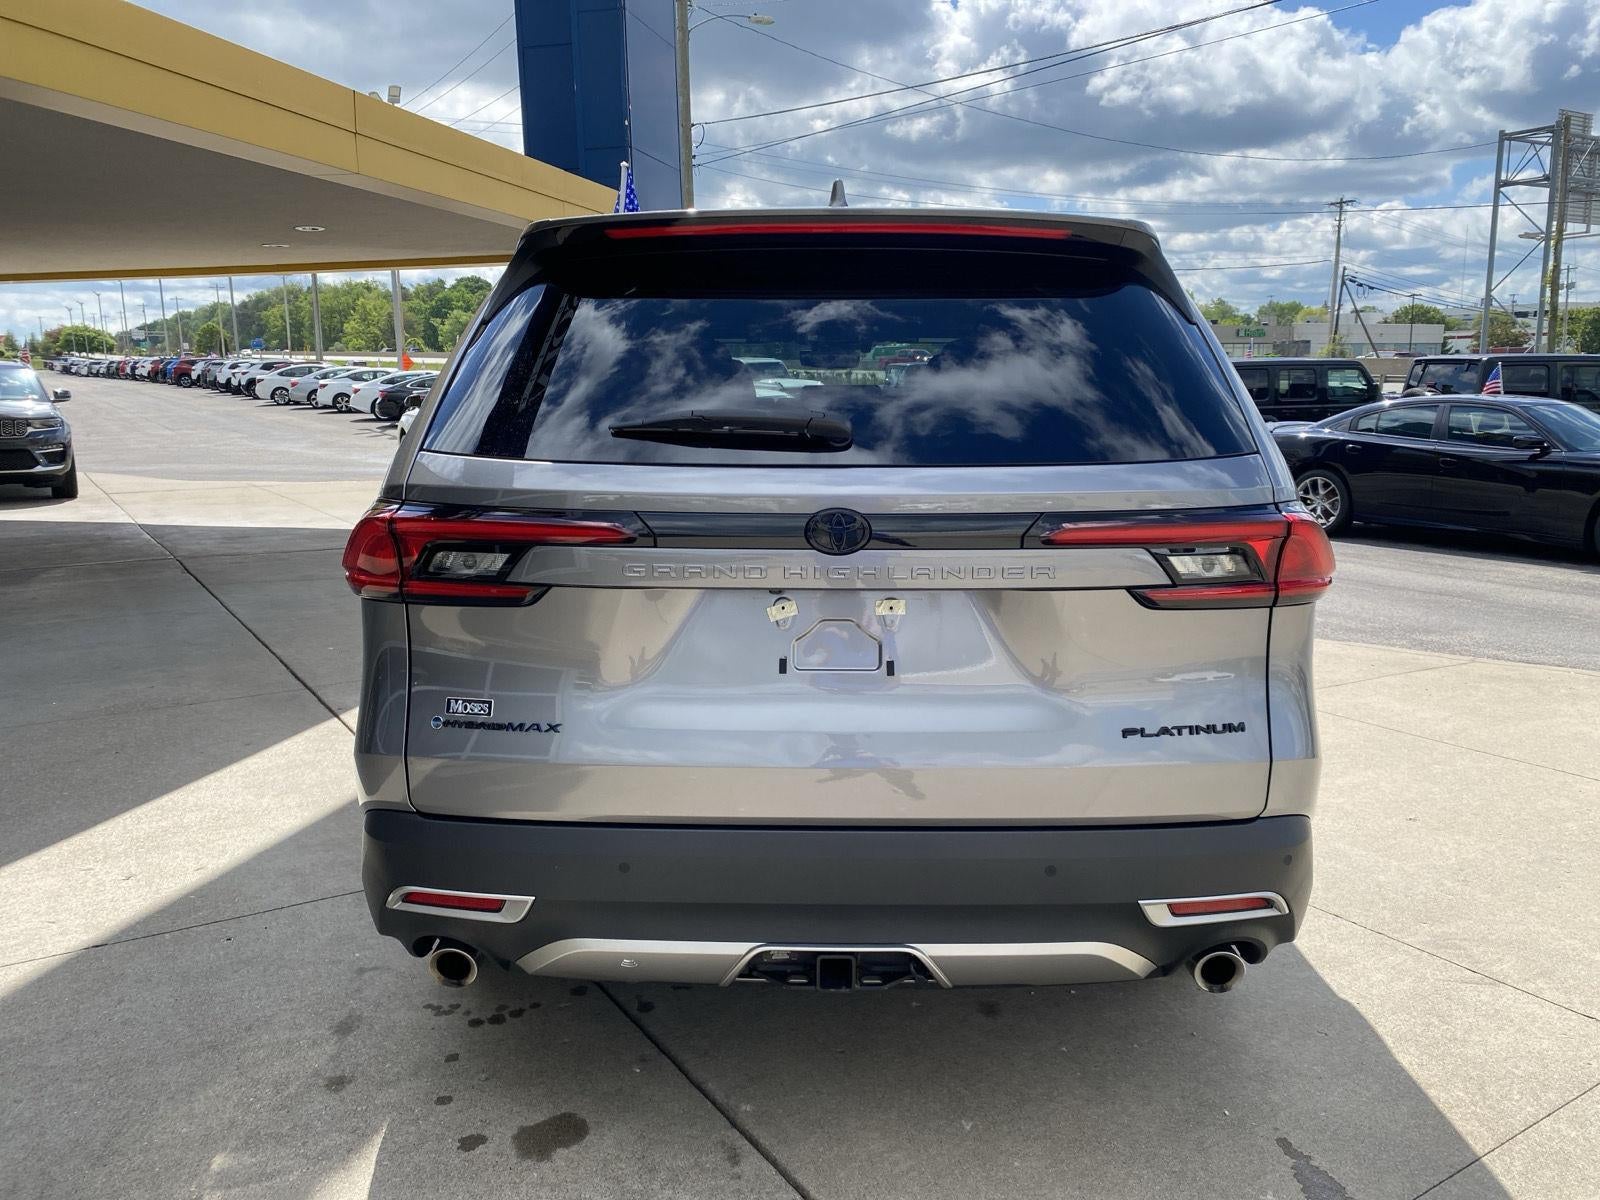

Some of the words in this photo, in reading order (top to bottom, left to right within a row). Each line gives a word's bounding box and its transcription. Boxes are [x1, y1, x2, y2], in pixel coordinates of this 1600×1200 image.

[622, 563, 768, 580] GRAND
[783, 565, 1056, 580] HIGHLANDER
[1121, 721, 1246, 739] PLATINUM
